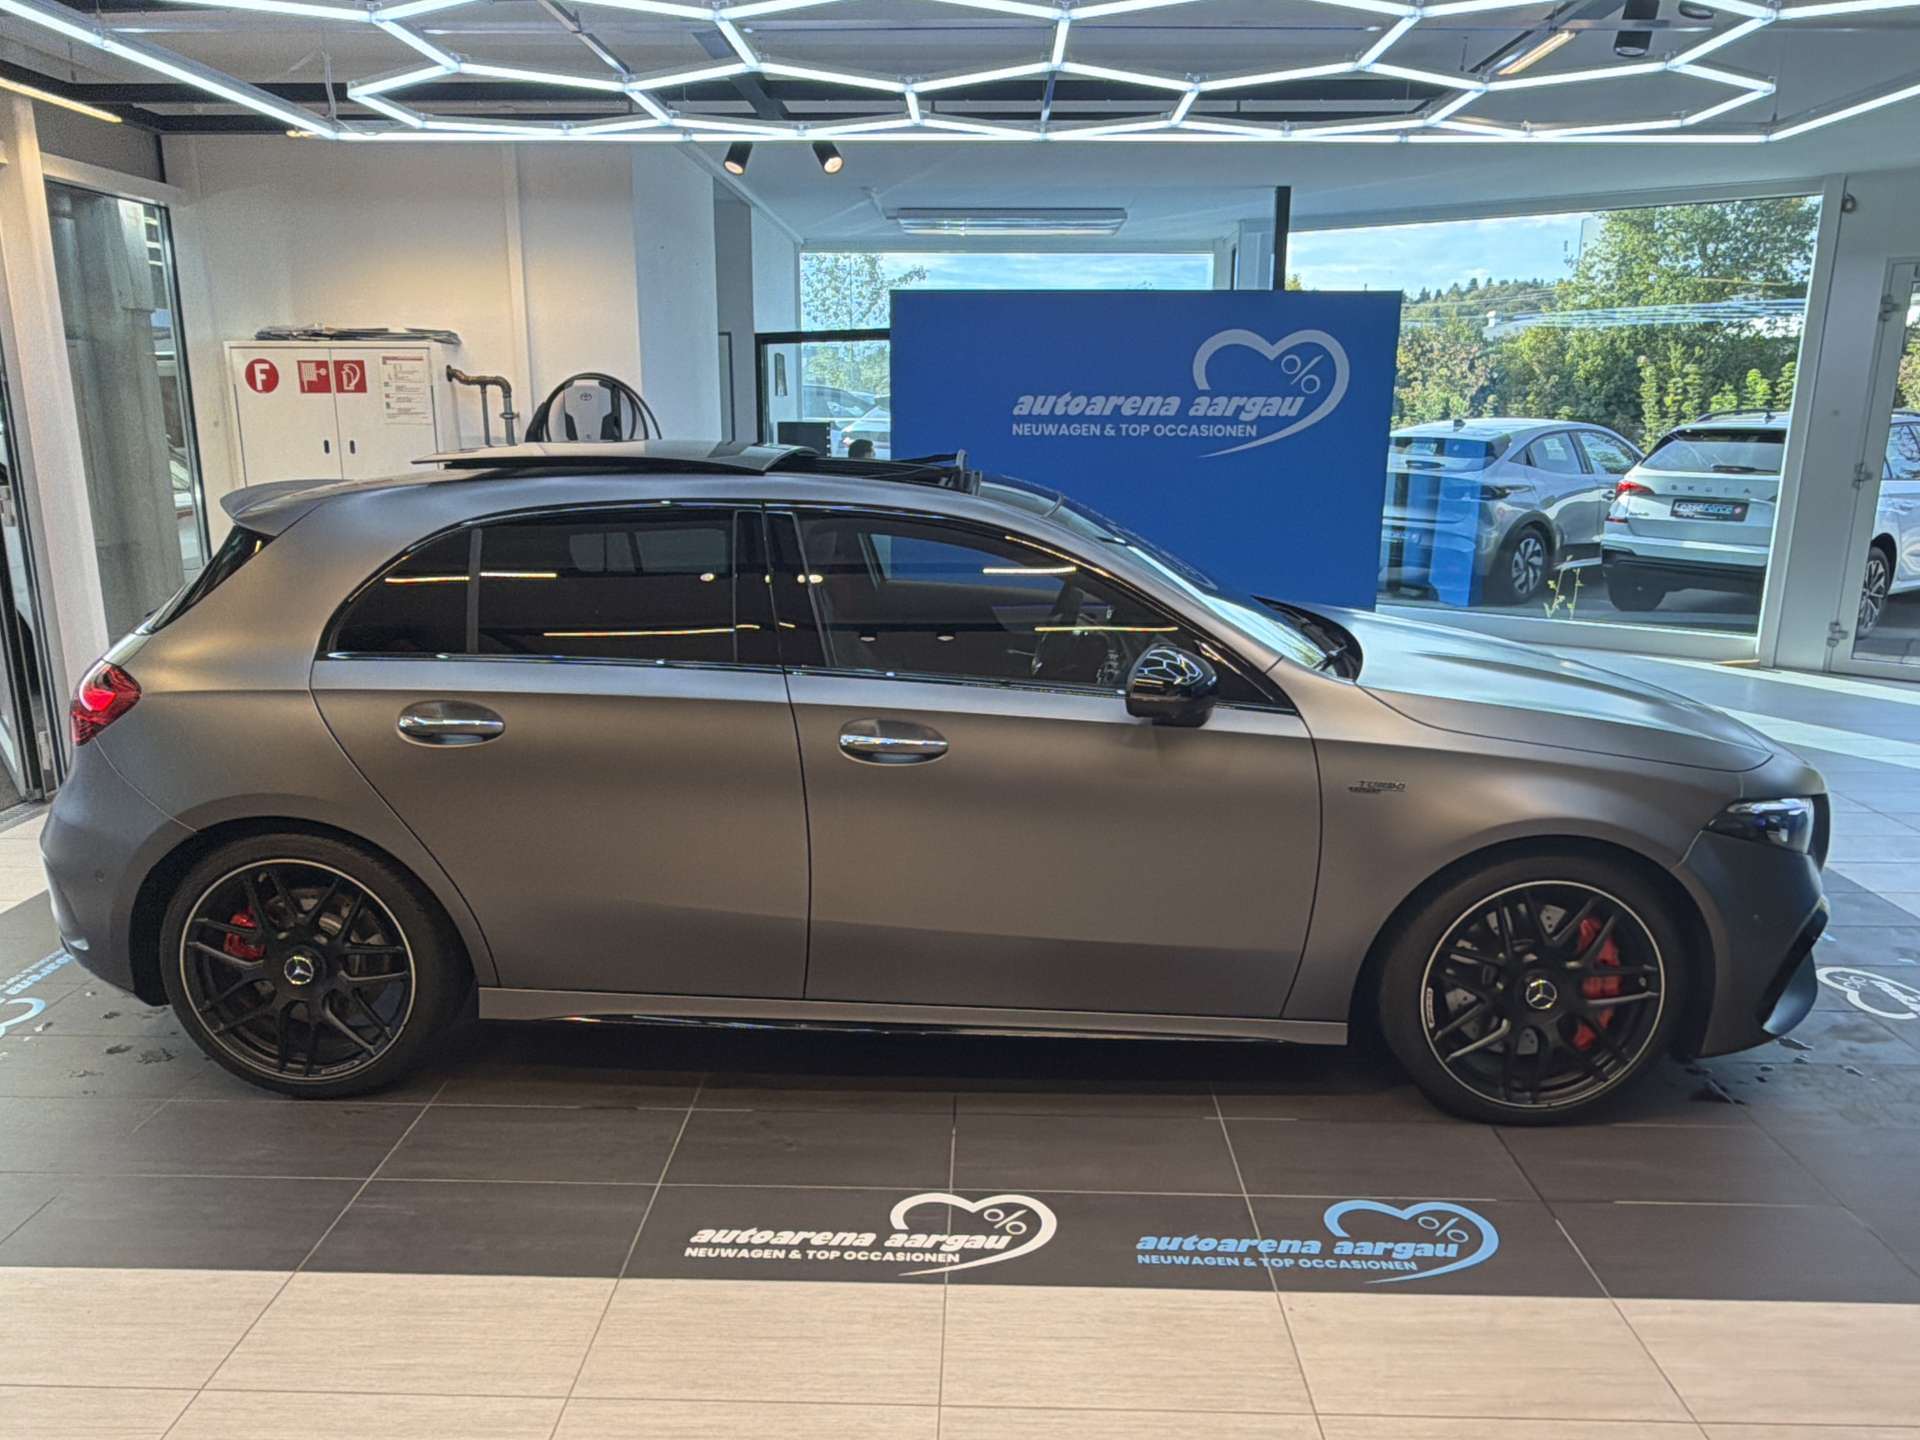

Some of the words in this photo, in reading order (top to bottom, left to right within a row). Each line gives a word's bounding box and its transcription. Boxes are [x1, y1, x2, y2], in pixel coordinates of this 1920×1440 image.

[254, 363, 271, 391] F
[1012, 391, 1181, 417] autoarena
[1188, 395, 1305, 422] aargau
[1012, 423, 1100, 437] NEUWAGEN
[1104, 424, 1116, 437] &
[1120, 424, 1151, 438] TOP
[1153, 424, 1257, 439] OCCASIONEN
[689, 1226, 876, 1248] autoarena
[884, 1231, 1013, 1252] aargau
[1136, 1233, 1321, 1256] autoarena
[1333, 1239, 1459, 1260] aargau
[684, 1246, 786, 1260] NEUWAGEN
[788, 1250, 802, 1260] &
[806, 1249, 841, 1261] TOP
[843, 1250, 960, 1264] OCCASIONEN
[1137, 1254, 1240, 1267] NEUWAGEN
[1244, 1257, 1256, 1267] &
[1258, 1257, 1295, 1269] TOP
[1298, 1258, 1417, 1271] OCCASIONEN
